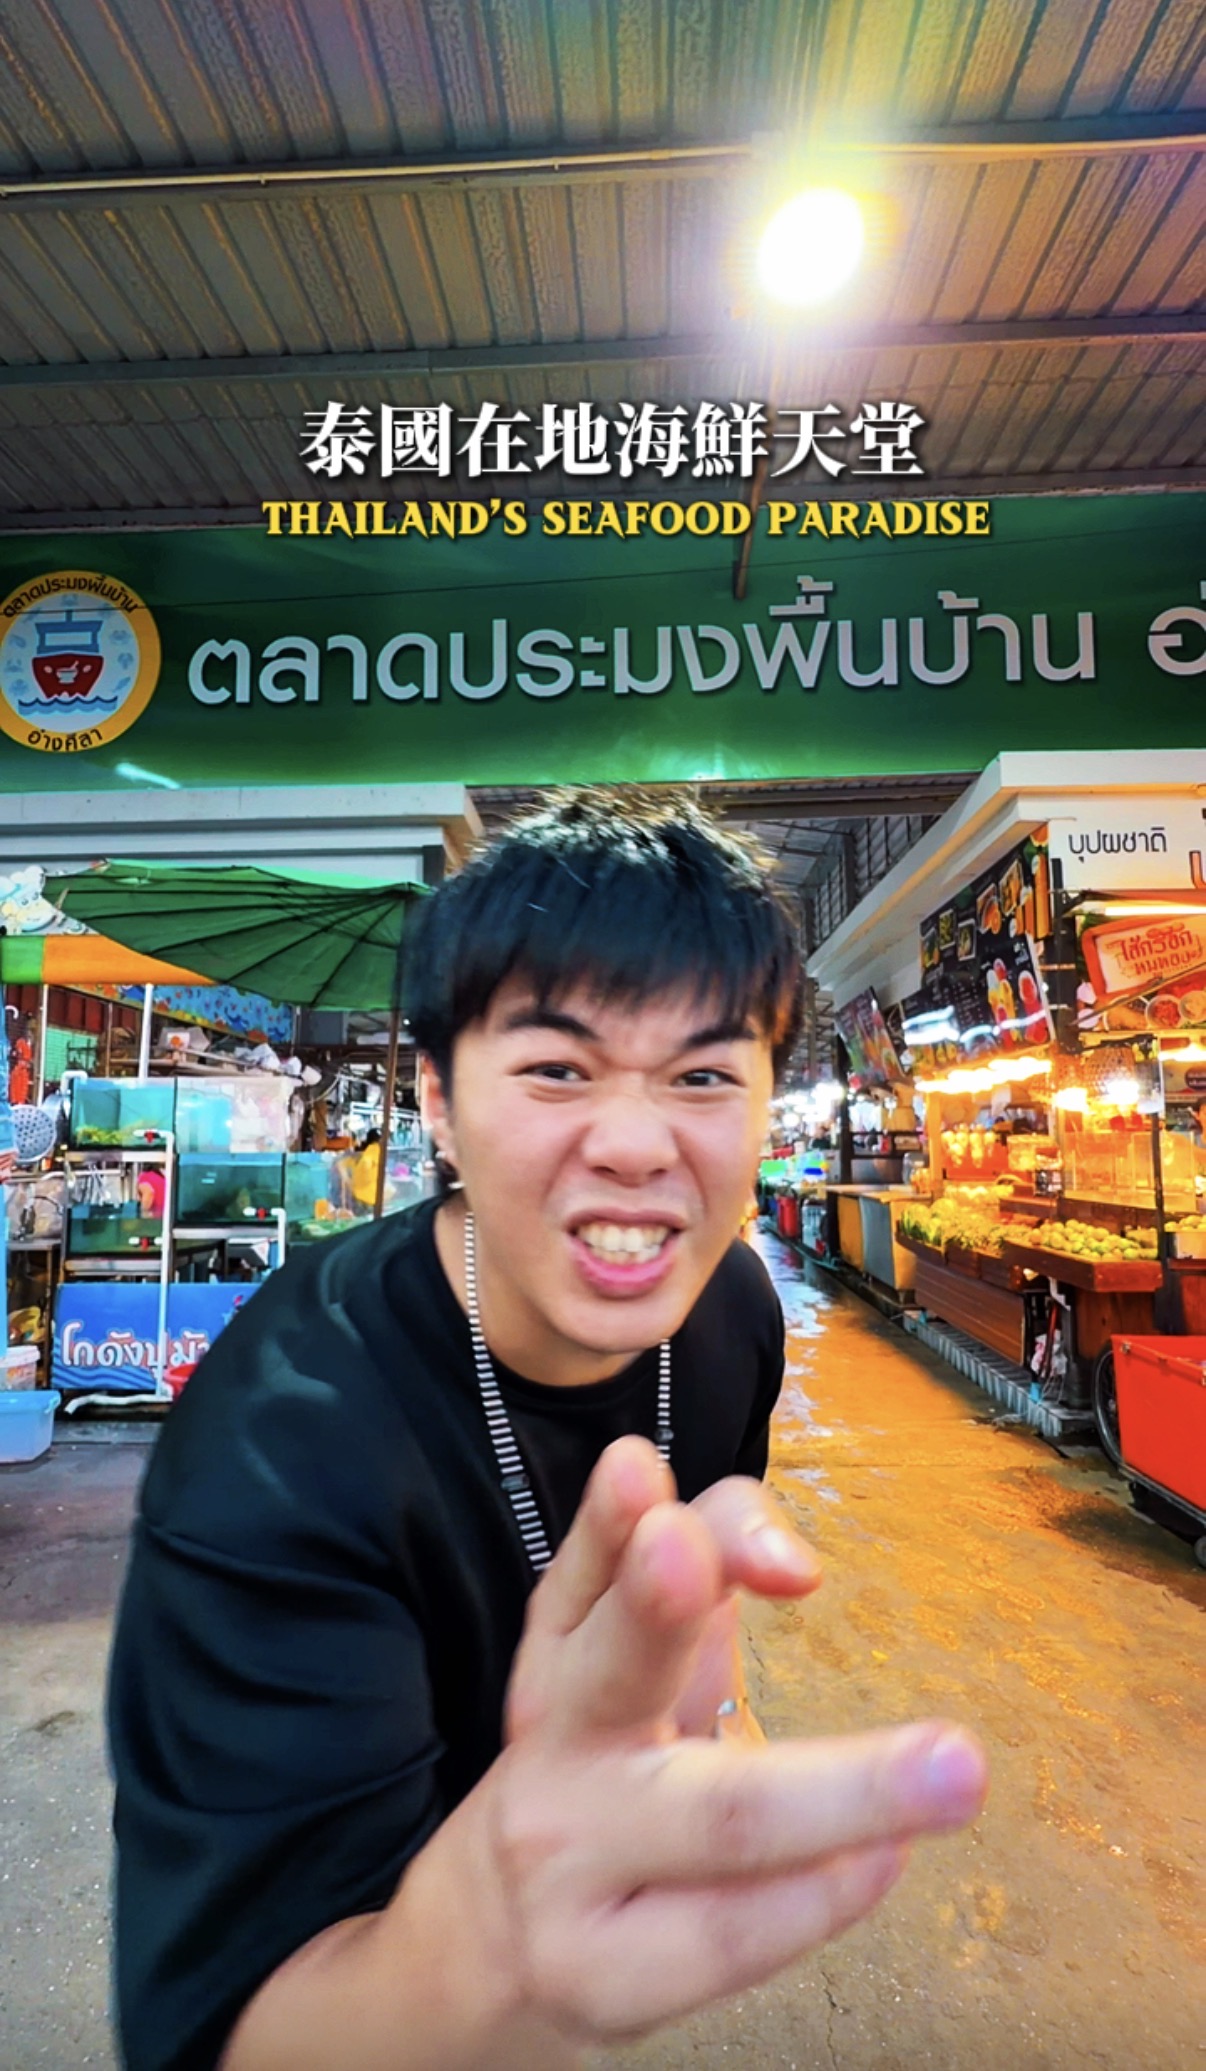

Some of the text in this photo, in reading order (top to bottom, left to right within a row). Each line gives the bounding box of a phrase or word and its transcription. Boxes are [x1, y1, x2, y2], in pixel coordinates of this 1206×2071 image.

[3, 575, 138, 618] ตลาดประมงพื้นบ้าน
[188, 575, 1096, 704] ตลาดประมงพื้นบ้าน
[1068, 826, 1167, 863] บุปผชาติ
